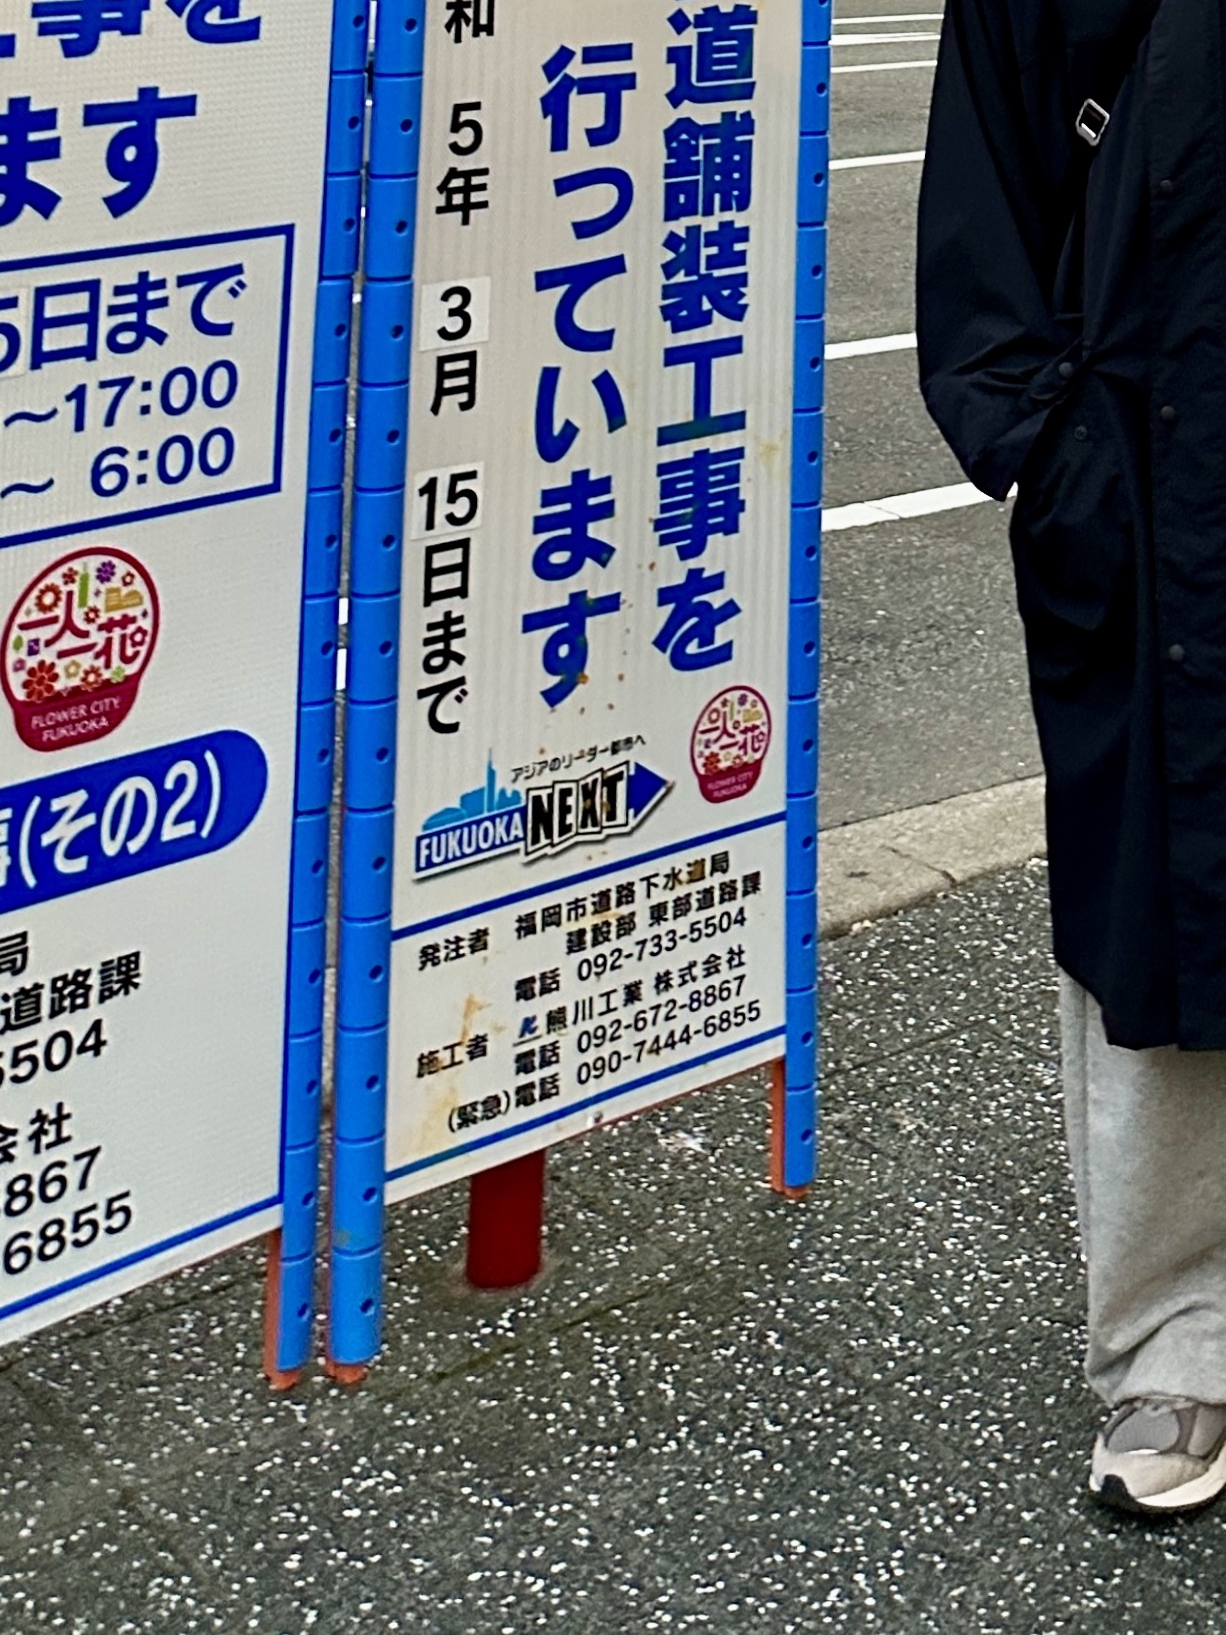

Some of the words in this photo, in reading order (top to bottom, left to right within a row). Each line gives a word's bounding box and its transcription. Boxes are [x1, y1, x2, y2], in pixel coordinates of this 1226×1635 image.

[521, 42, 637, 709] 行っています
[90, 427, 235, 498] 6:00
[416, 469, 479, 735] 15日まで
[31, 705, 87, 728] FLOWER
[90, 696, 120, 714] CITY
[41, 716, 109, 742] FUKUOKA
[0, 752, 219, 889] (その2)
[420, 811, 524, 868] FUKUOKA
[530, 769, 625, 847] NEXT
[418, 927, 490, 971] 発注者
[515, 850, 730, 940] 福岡市道路下水道局
[566, 911, 637, 956] 建設部
[648, 870, 762, 927] 東部道路課
[0, 951, 142, 1036] 道路課
[514, 967, 561, 1002] 電話
[577, 906, 747, 982] 092-733-5504
[0, 1017, 108, 1089] 504
[514, 1040, 561, 1076] 電話
[577, 974, 747, 1054] 092-672-8867
[576, 999, 762, 1086] 090-7444-6855
[4, 1145, 102, 1218] 867
[3, 1189, 132, 1275] 6855
